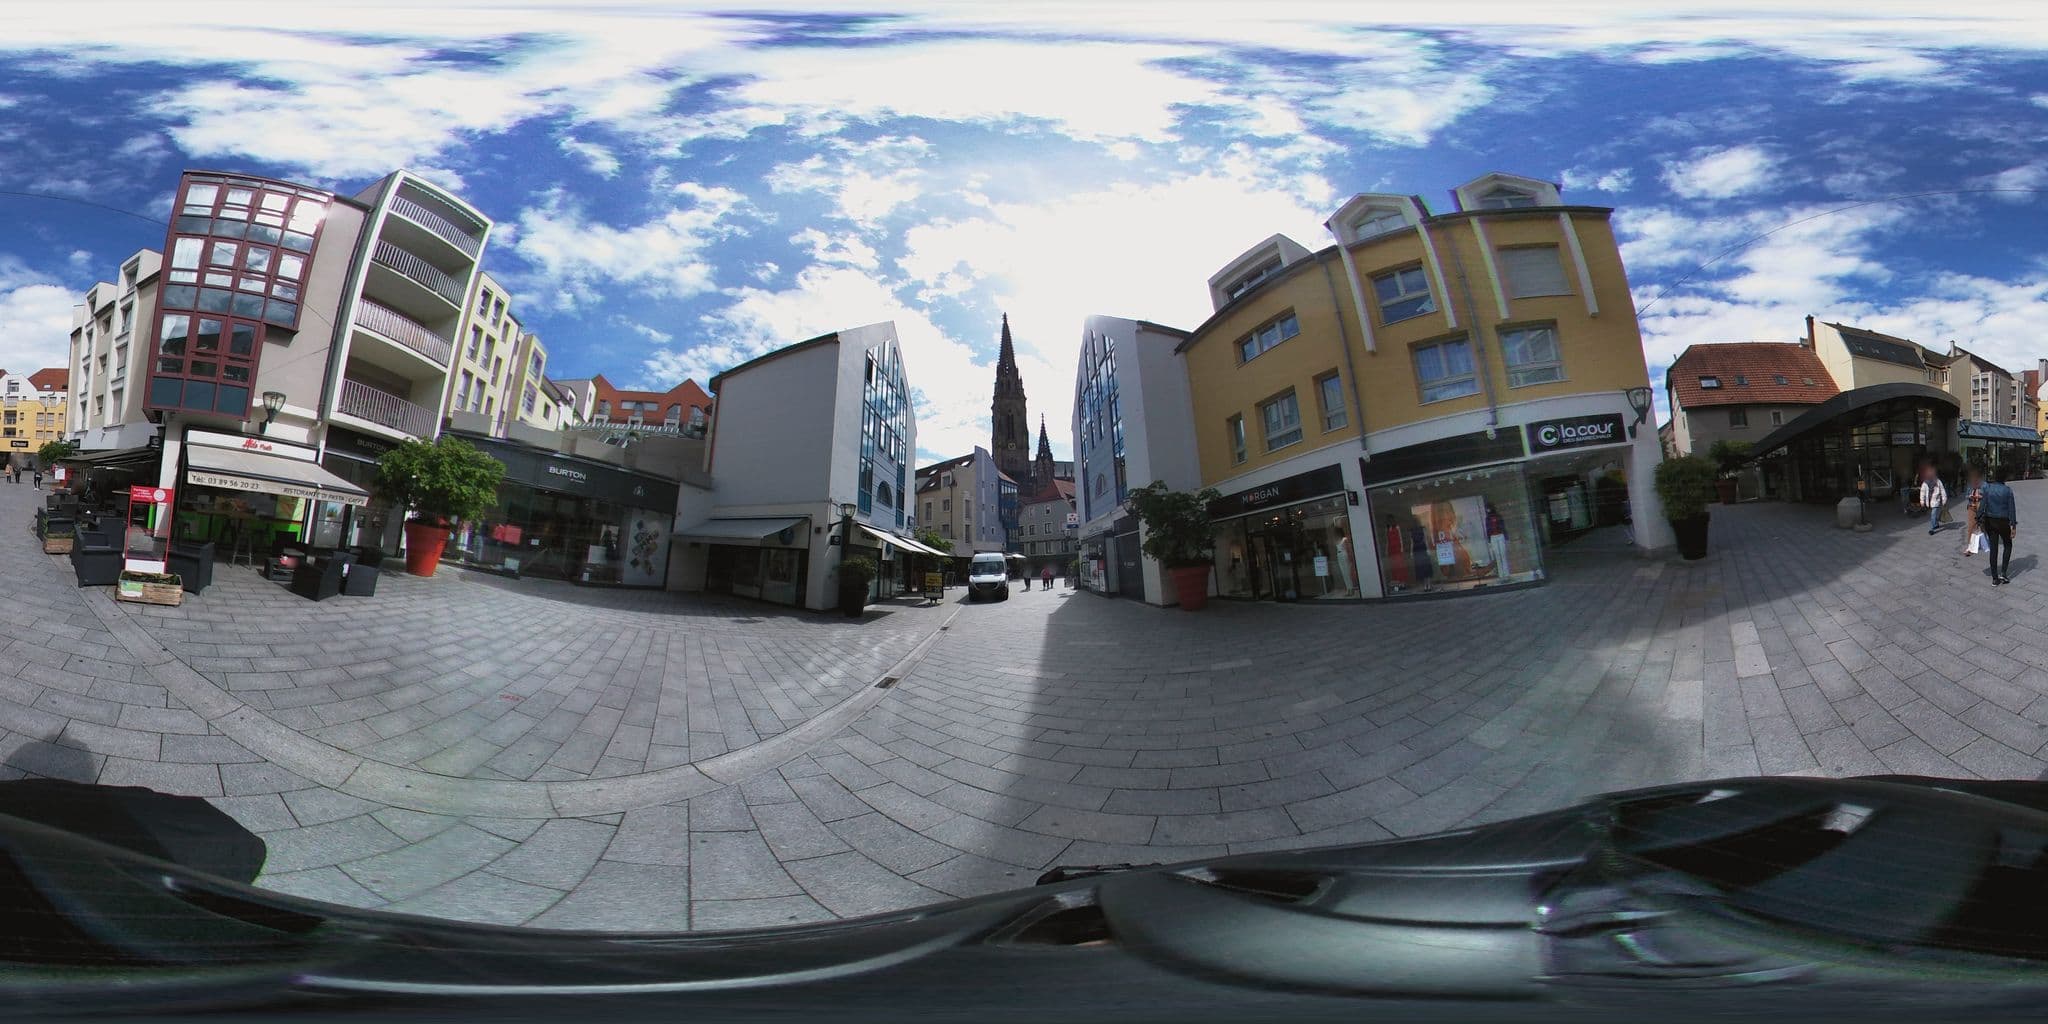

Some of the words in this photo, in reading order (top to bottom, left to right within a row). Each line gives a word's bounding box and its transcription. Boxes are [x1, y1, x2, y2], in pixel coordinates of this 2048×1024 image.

[1560, 424, 1576, 438] la
[1577, 422, 1614, 436] cour
[549, 466, 586, 480] BURTON
[218, 478, 228, 486] 89
[1241, 487, 1279, 504] MORGAN
